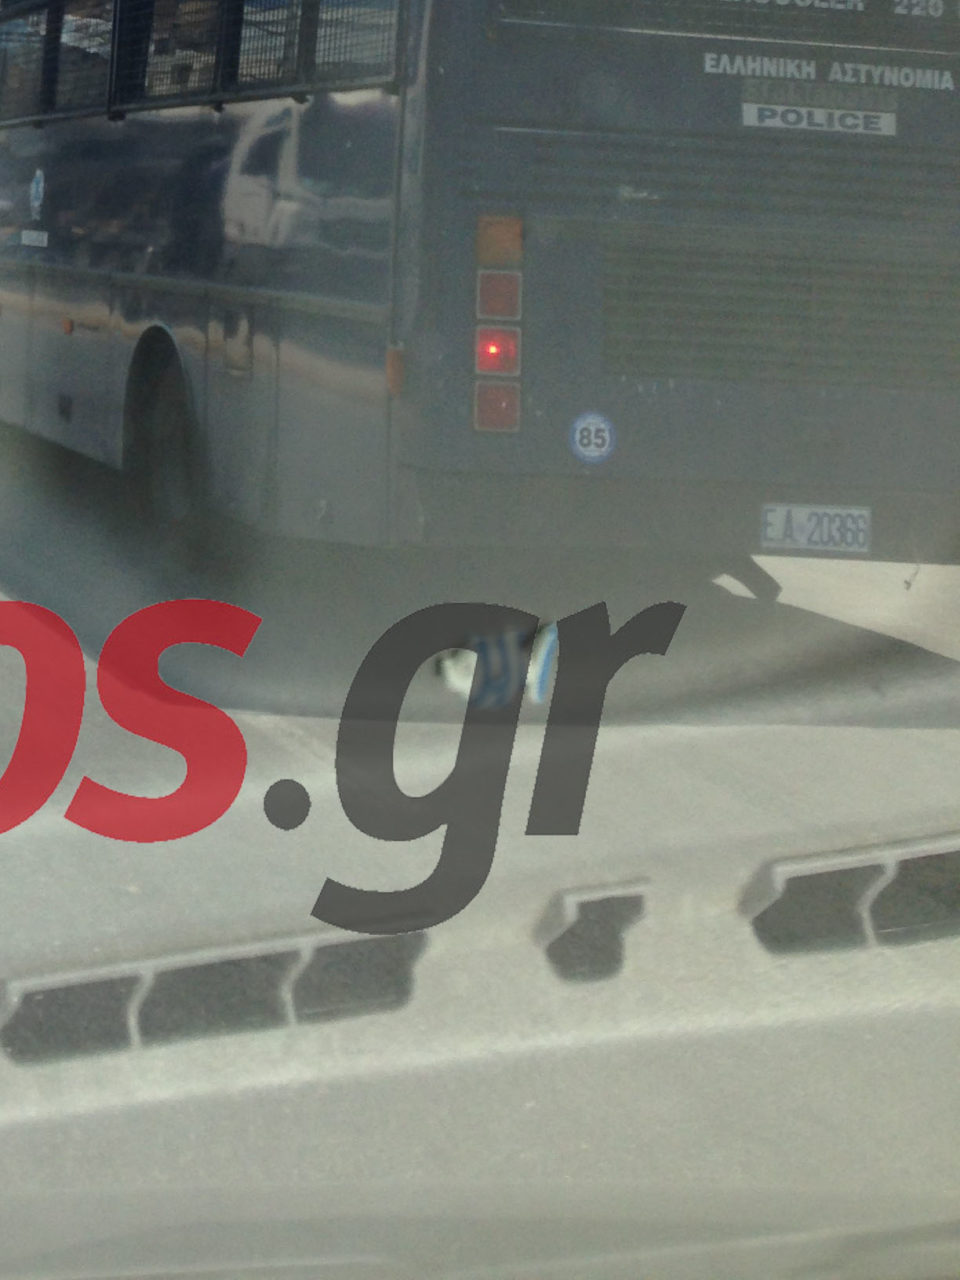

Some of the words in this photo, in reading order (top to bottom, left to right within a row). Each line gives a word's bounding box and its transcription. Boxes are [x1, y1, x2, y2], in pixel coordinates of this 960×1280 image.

[703, 52, 816, 80] ΕΛΛΗΝΙΚΗ
[828, 62, 955, 90] ΑΣΤΥΝΟΜΙΑ
[757, 107, 882, 131] POLICE
[579, 427, 607, 449] 85
